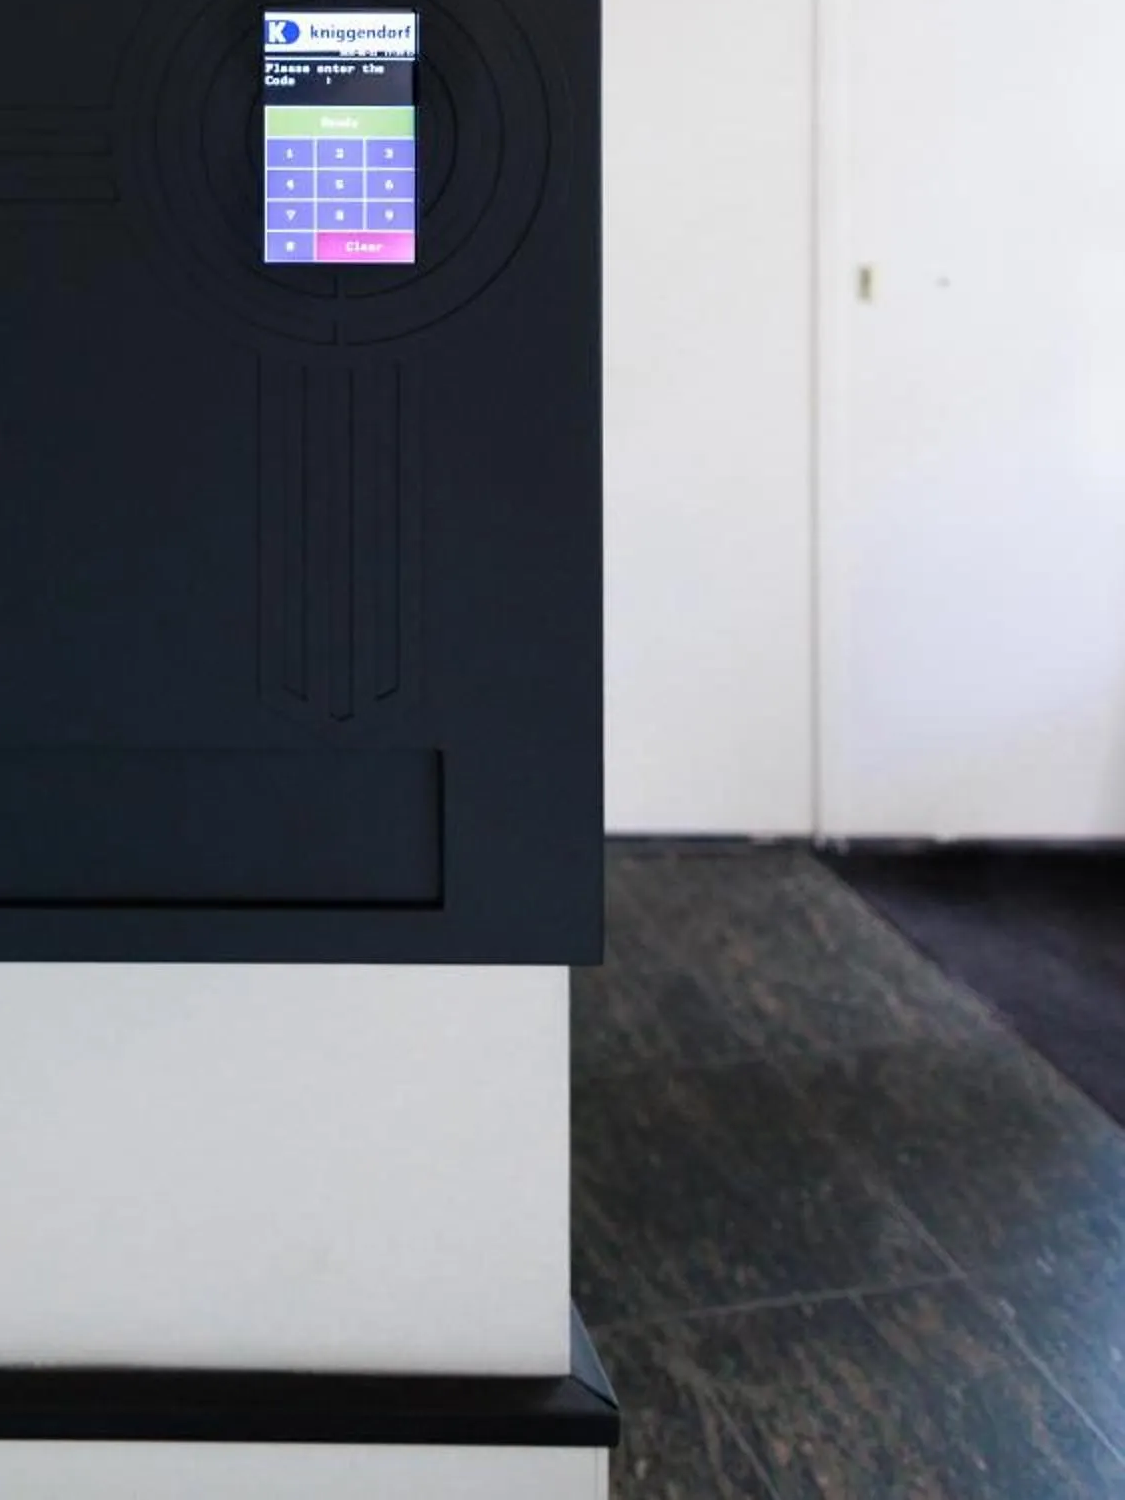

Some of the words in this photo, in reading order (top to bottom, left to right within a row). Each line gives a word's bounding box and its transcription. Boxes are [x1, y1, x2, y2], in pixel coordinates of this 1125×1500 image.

[310, 25, 411, 42] kniggendorf
[265, 64, 310, 73] Please
[317, 64, 355, 73] enter
[362, 63, 385, 73] the
[265, 76, 295, 85] Code
[286, 148, 294, 159] 1
[335, 148, 344, 159] 2
[384, 148, 394, 159] 3
[286, 179, 295, 190] 4
[335, 179, 345, 189] 5
[385, 180, 394, 190] 6
[286, 210, 295, 221] 7
[335, 210, 344, 221] 8
[385, 210, 394, 220] 9
[346, 242, 383, 252] Clear
